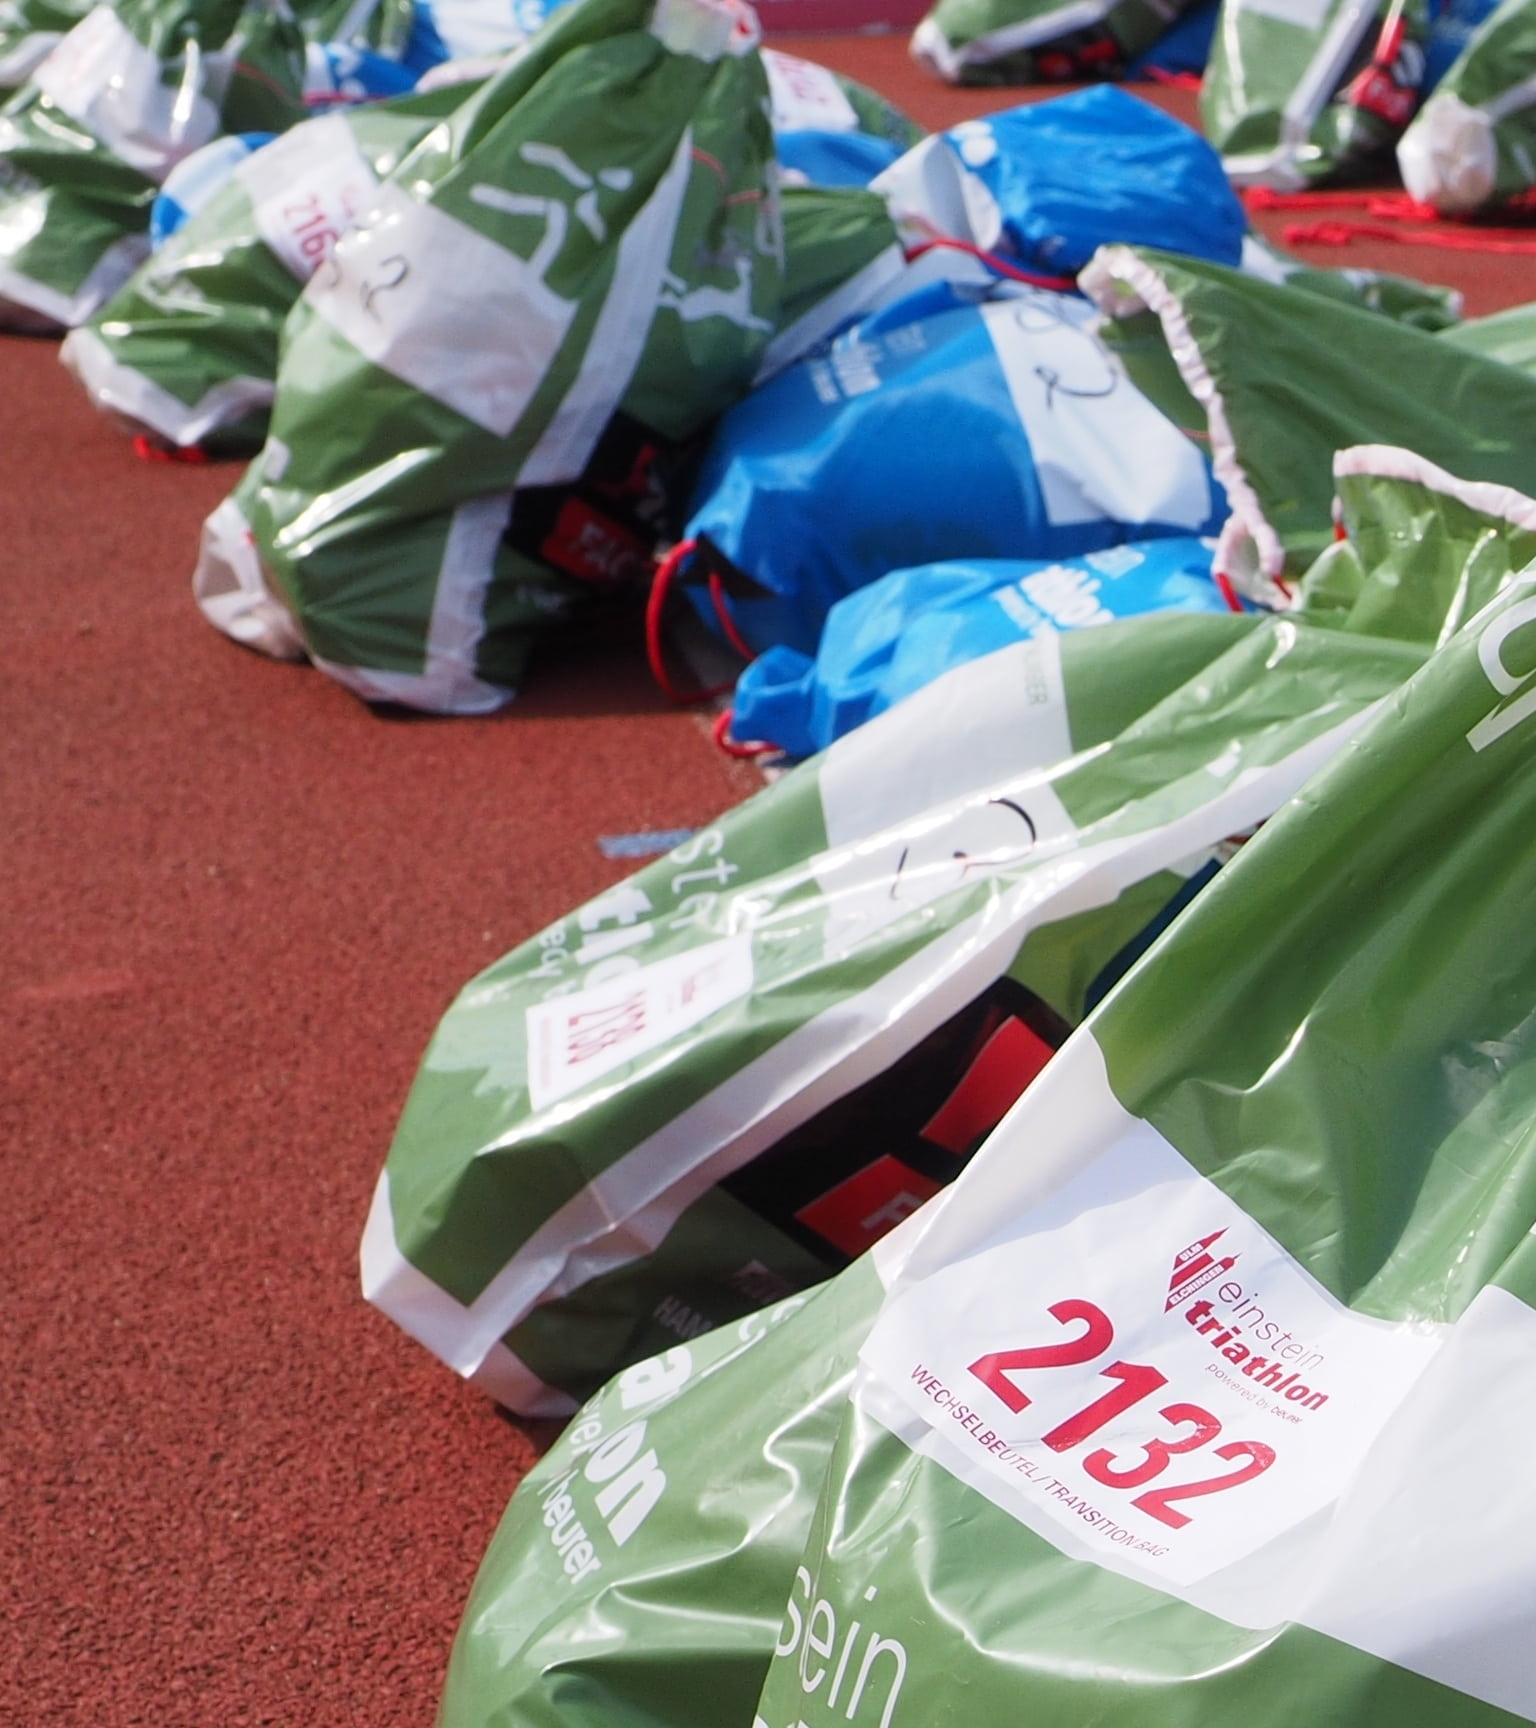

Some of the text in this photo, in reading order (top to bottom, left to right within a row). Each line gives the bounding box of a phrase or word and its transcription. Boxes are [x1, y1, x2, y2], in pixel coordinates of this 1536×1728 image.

[1168, 1262, 1226, 1306] ELCHINGEN
[1218, 1281, 1325, 1371] einstein
[1184, 1299, 1331, 1412] triathlon
[1205, 1363, 1258, 1402] powered
[909, 1363, 1039, 1480] WECHSELBEUTEL
[1043, 1479, 1140, 1549] TRANSITION
[966, 1297, 1279, 1532] 2132
